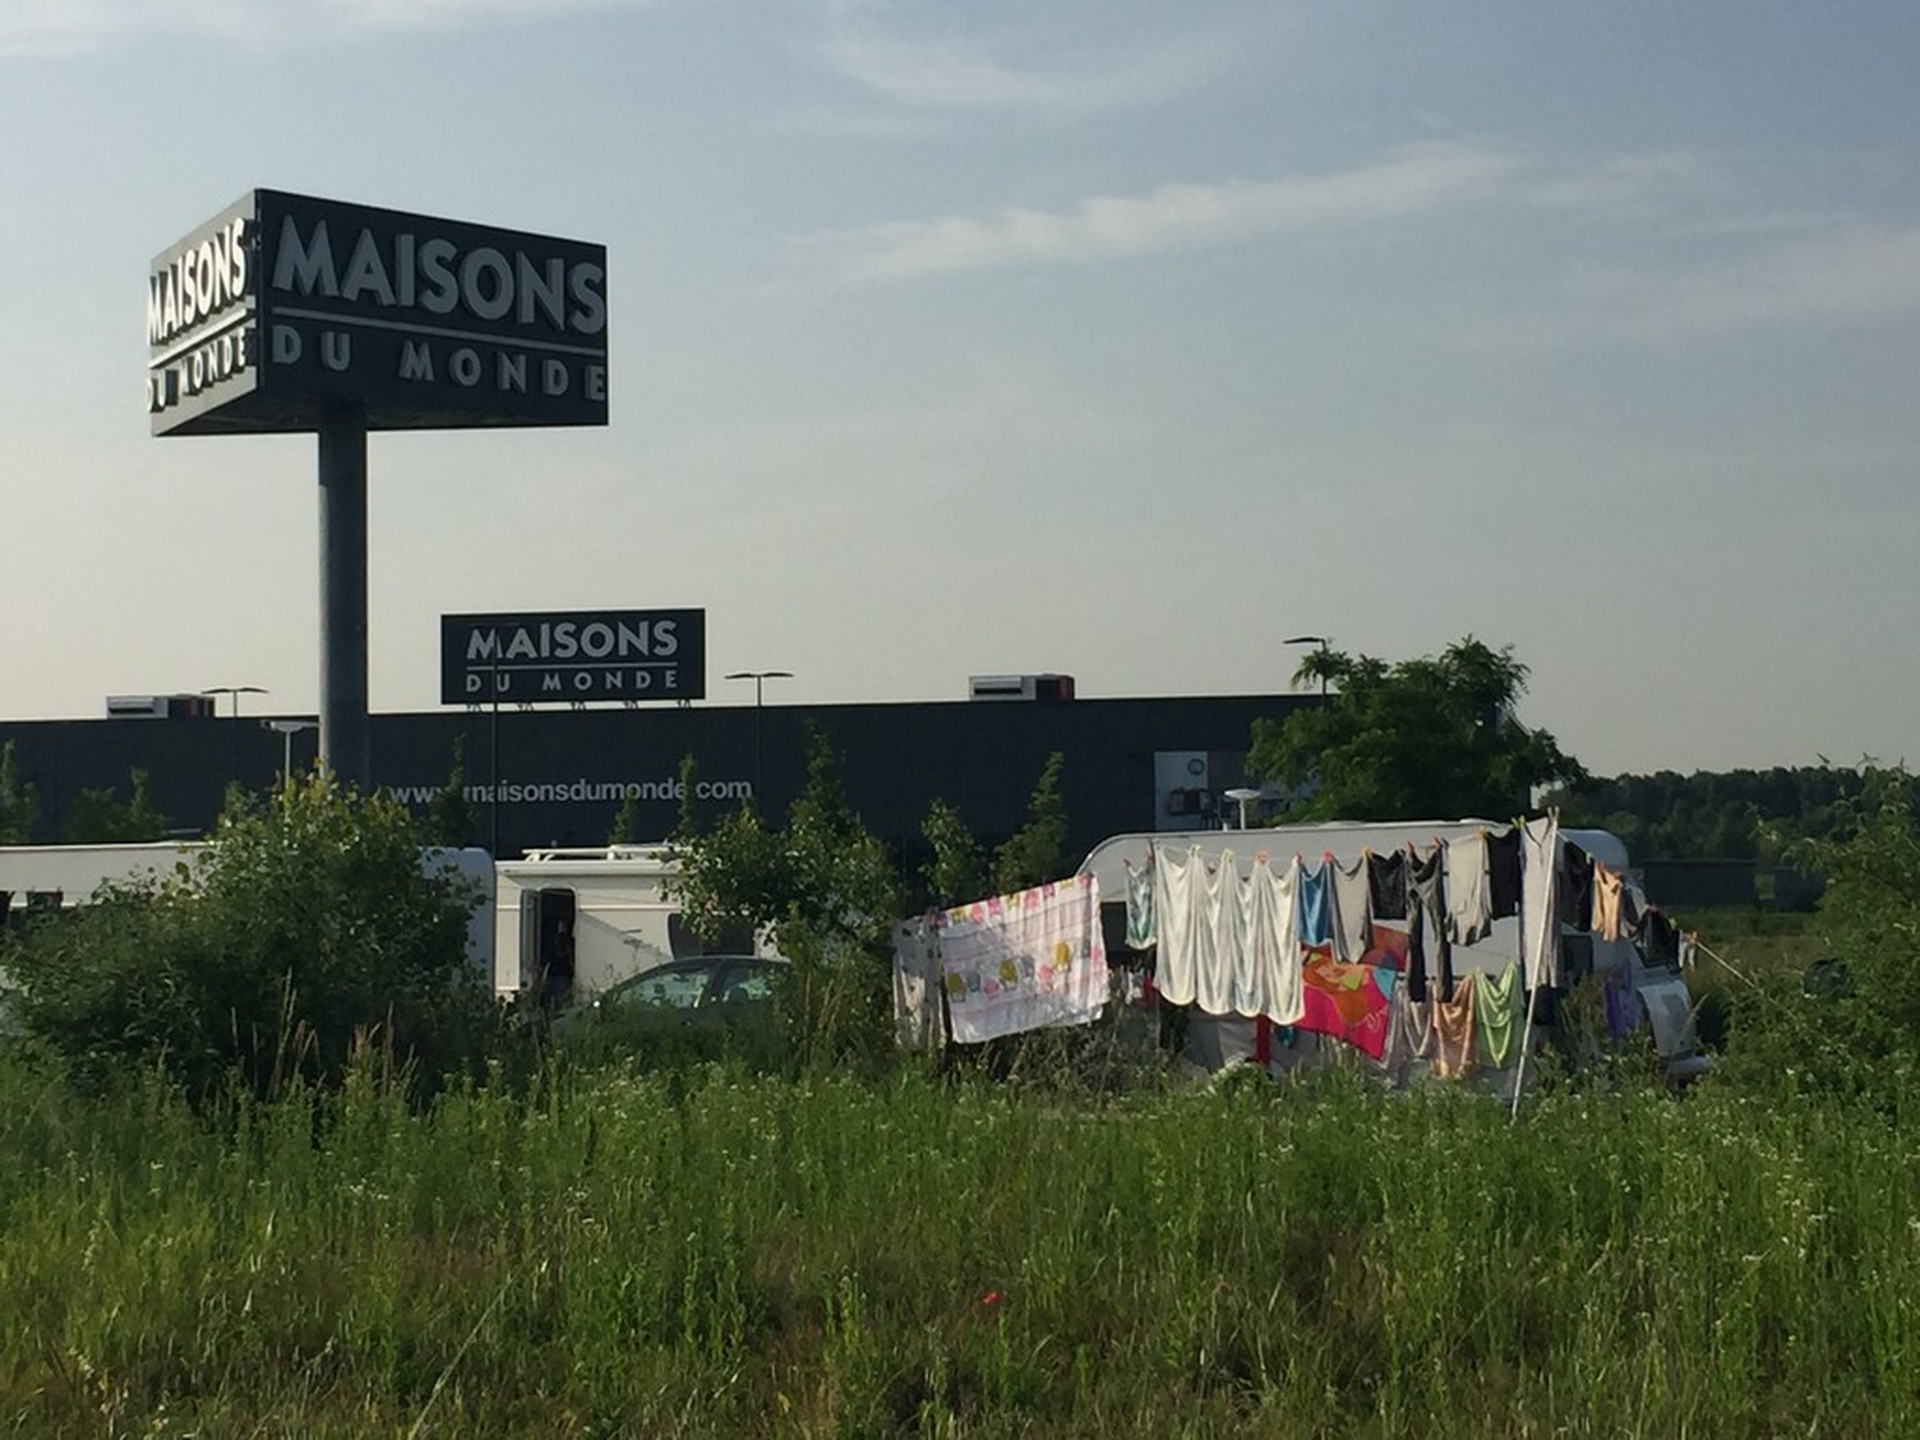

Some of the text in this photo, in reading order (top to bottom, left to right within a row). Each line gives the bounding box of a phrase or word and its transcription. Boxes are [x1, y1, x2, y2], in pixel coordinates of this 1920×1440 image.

[146, 216, 246, 344] MAISONS
[272, 215, 606, 334] MAISONS
[272, 326, 606, 400] DU MONDE
[467, 620, 678, 660] MAISONS
[466, 671, 677, 692] DU MONDE
[388, 777, 753, 804] wwmaisonsdumondecom
